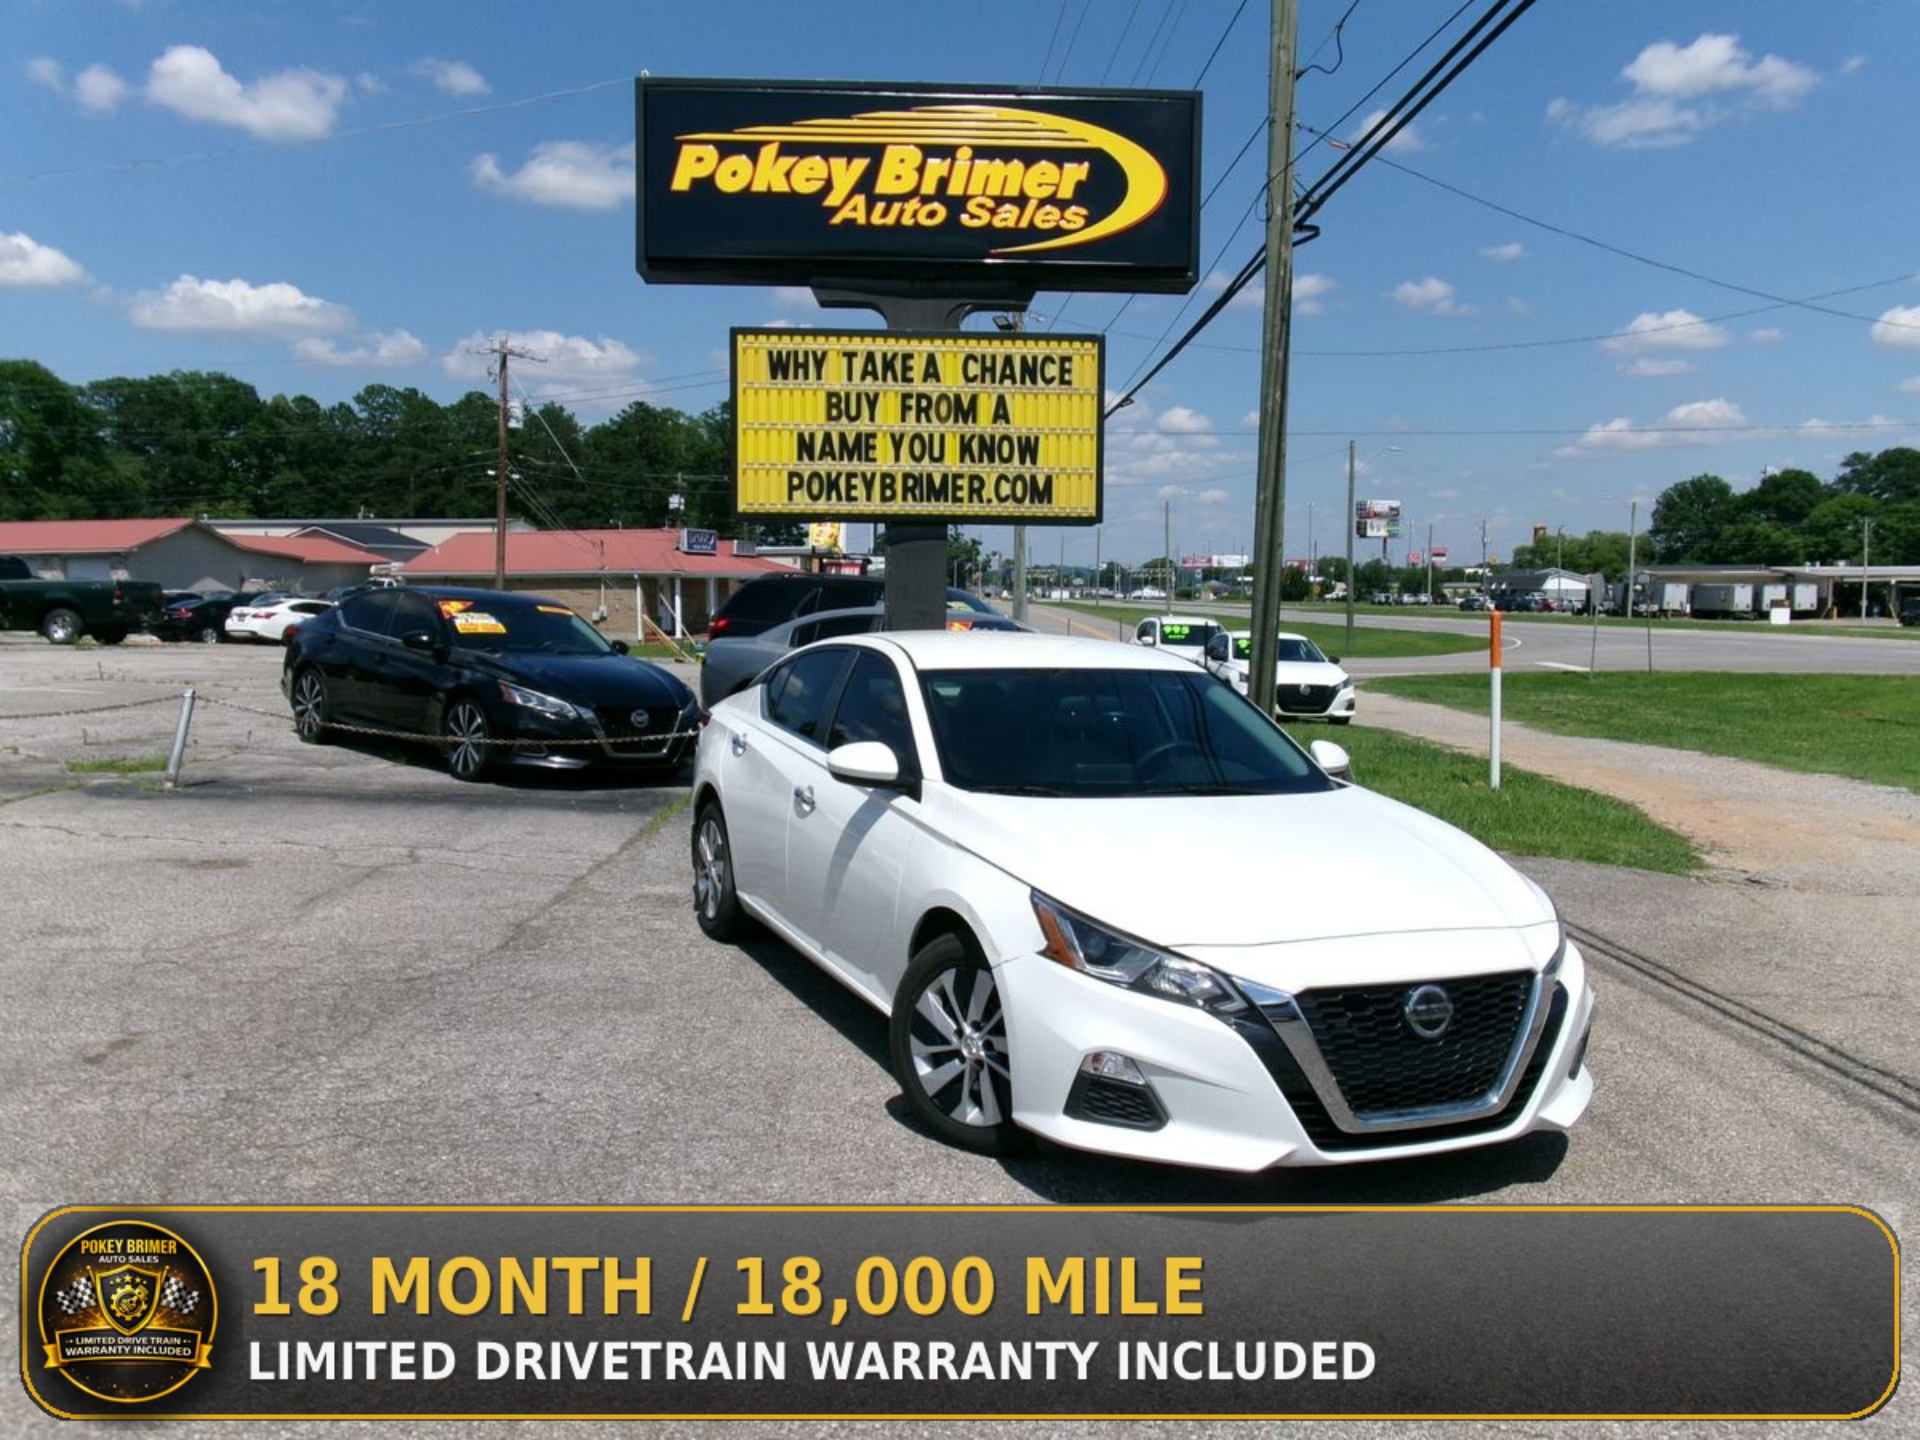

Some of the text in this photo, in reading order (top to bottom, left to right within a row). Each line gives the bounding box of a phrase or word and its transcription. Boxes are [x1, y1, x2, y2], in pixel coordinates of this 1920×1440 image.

[671, 142, 1091, 207] Pokey Brimer
[829, 195, 1088, 230] Auto Sales
[767, 350, 1074, 386] WHY TAKE A CHANCE
[825, 391, 1011, 425] BUY FROM A
[797, 431, 1040, 466] NAME YOU KNOW
[787, 471, 1053, 505] POKEYBRIMER.COM
